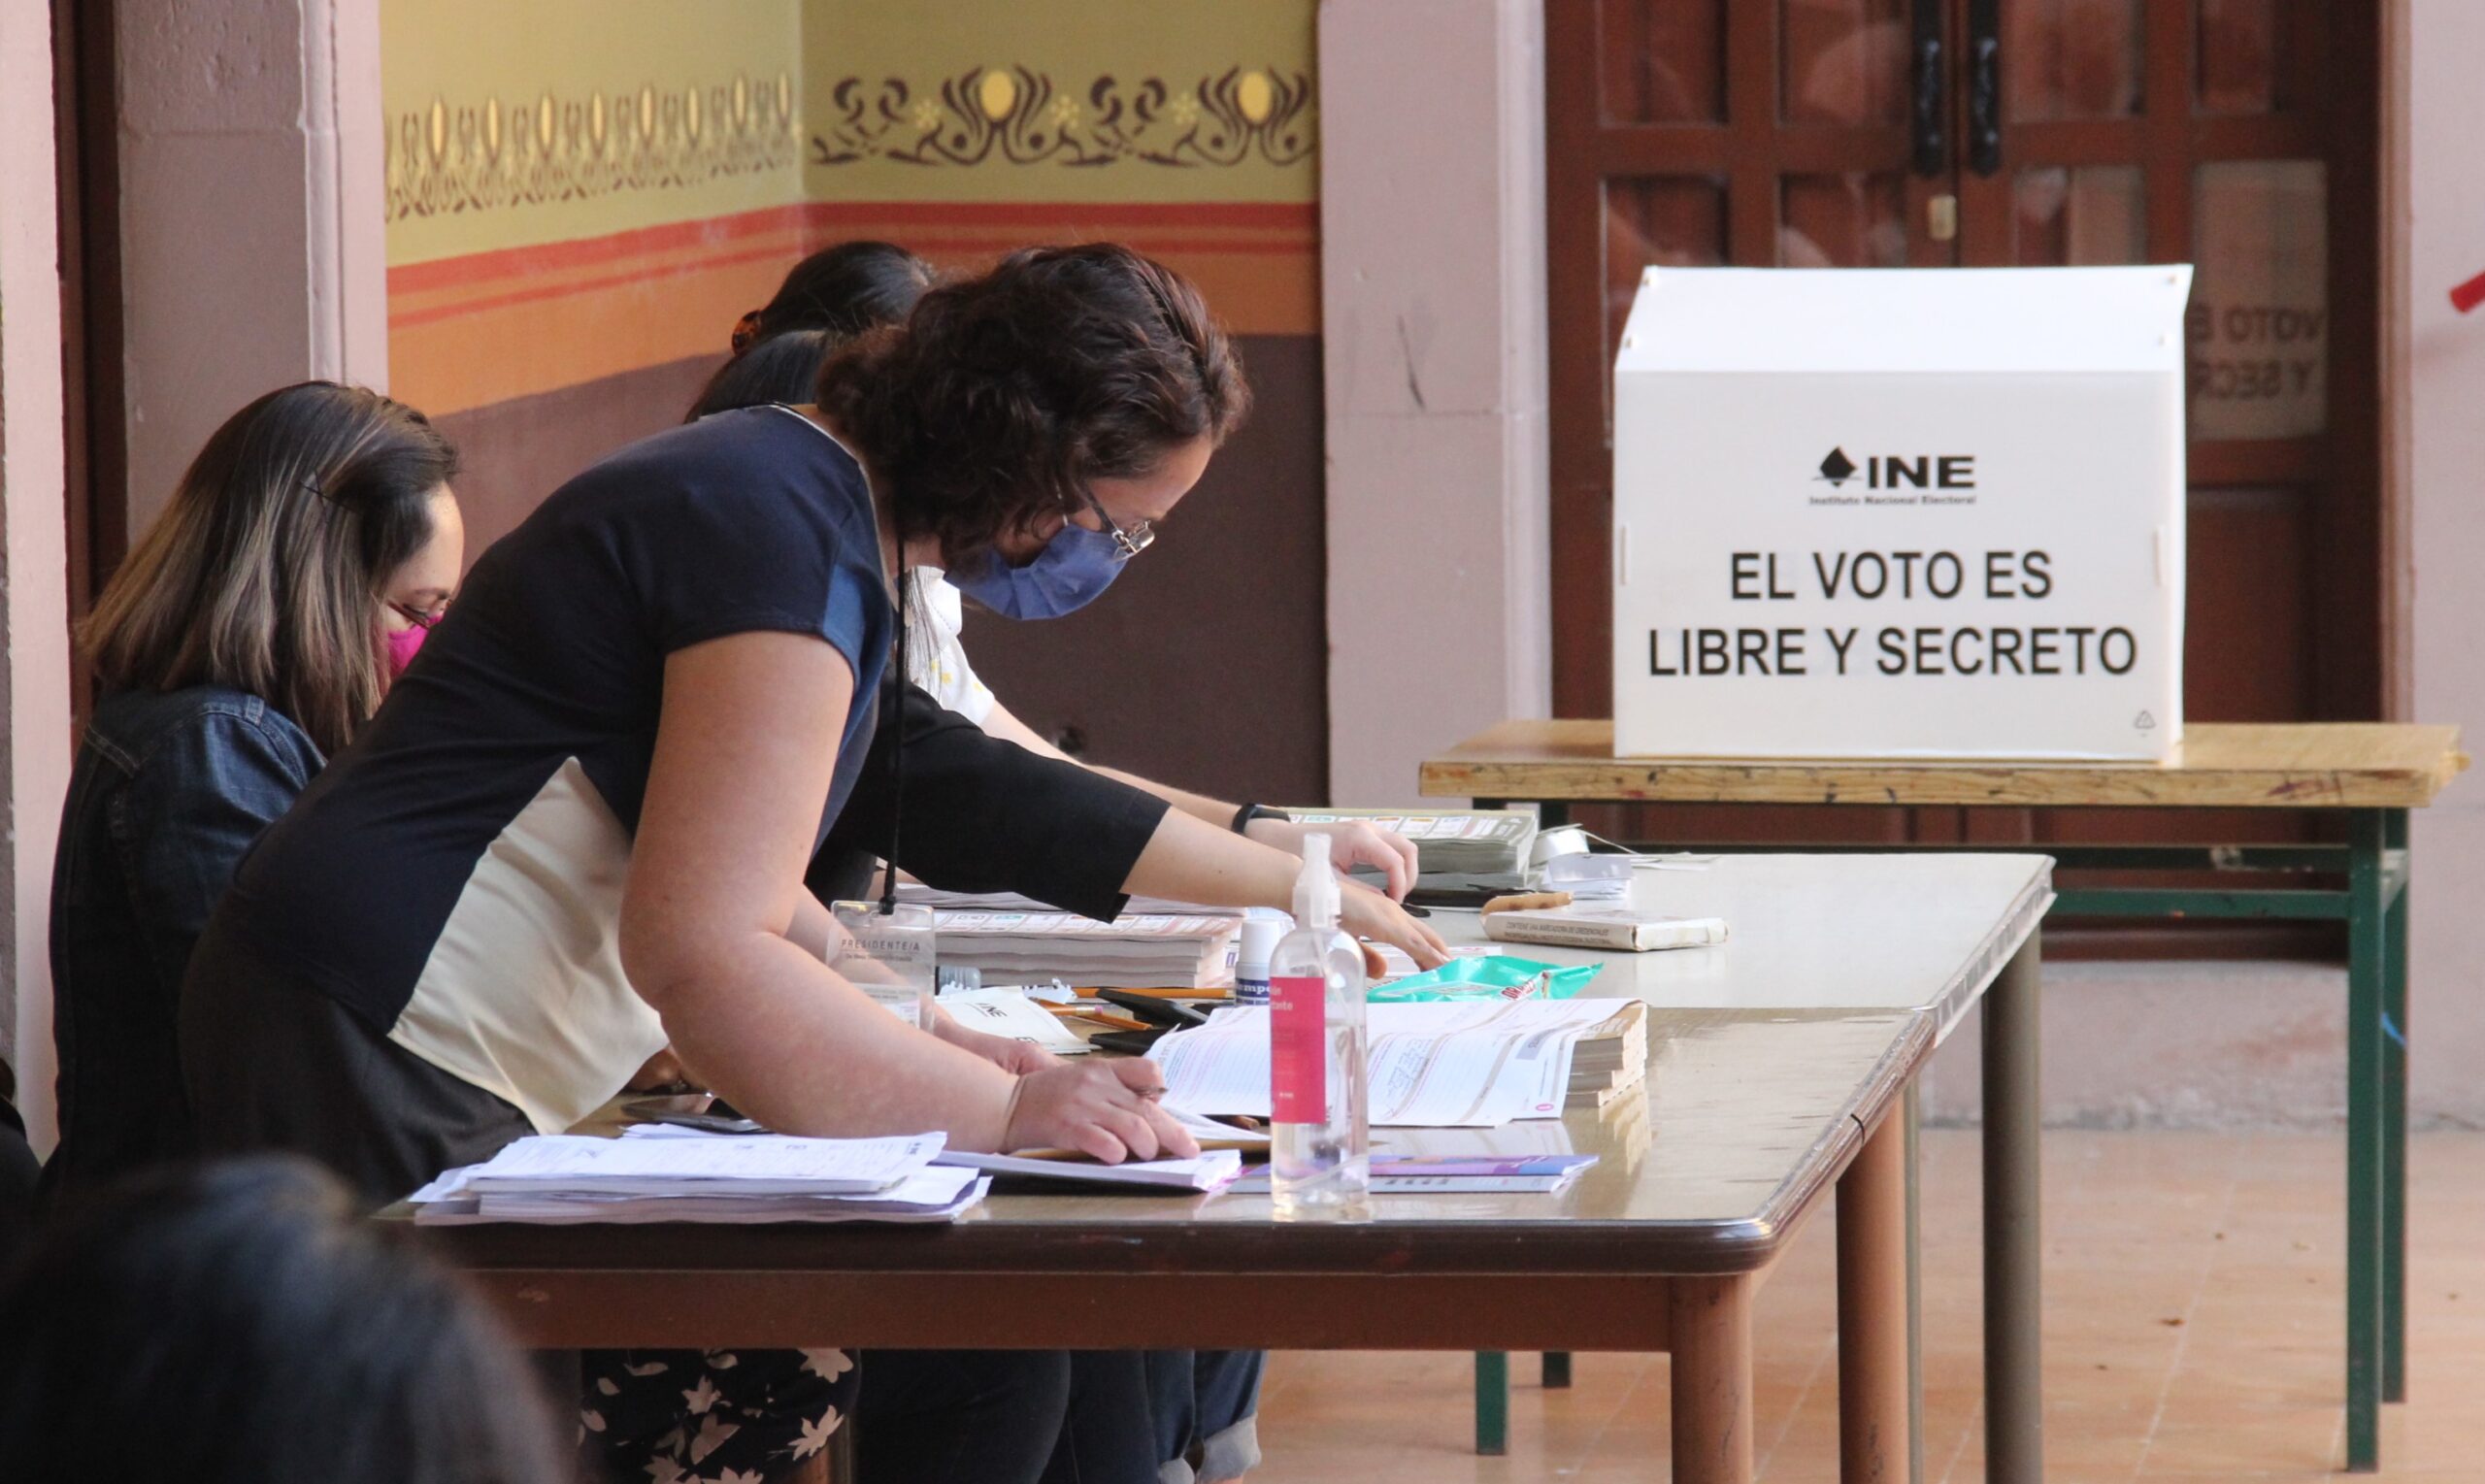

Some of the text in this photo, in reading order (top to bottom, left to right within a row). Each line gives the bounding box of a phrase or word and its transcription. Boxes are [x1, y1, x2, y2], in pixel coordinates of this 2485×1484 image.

[1869, 455, 1975, 489] INE
[1808, 495, 1977, 506] Instituto Nacional Electoral
[1732, 550, 2053, 601] EL VOTO ES
[1649, 626, 2138, 676] LIBRE Y SECRETO
[841, 939, 920, 951] PRESIDENTE/A
